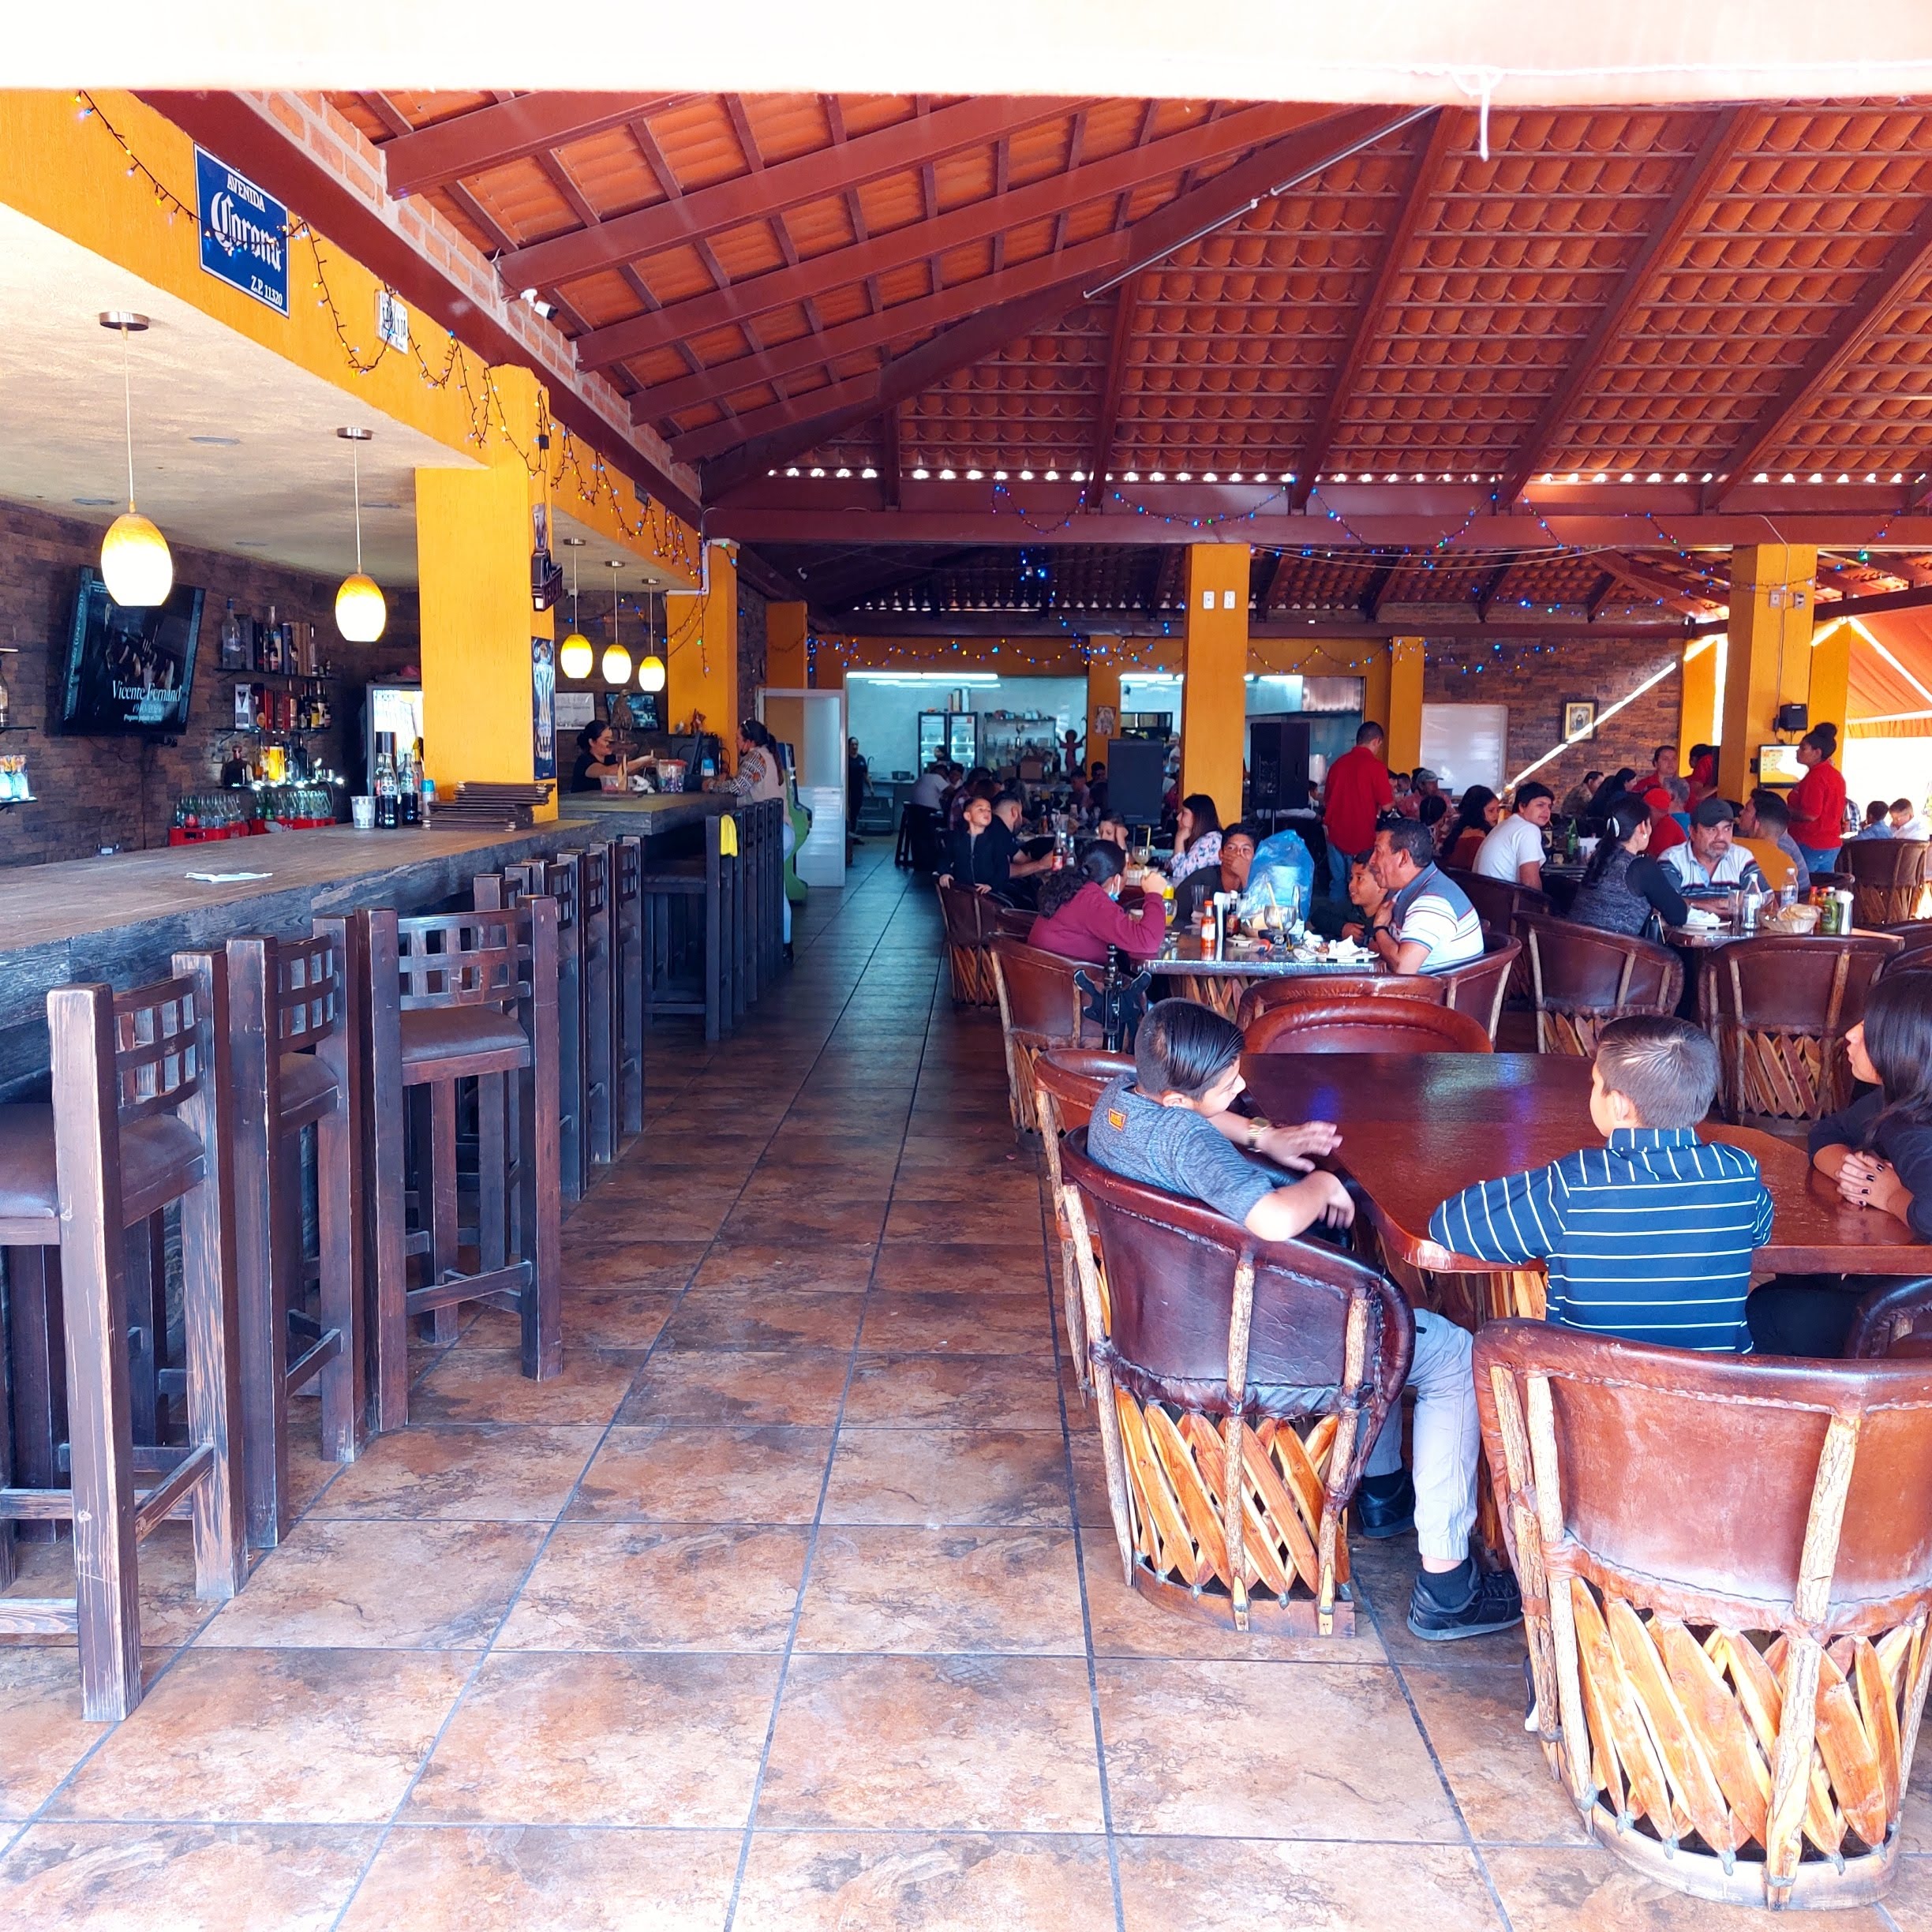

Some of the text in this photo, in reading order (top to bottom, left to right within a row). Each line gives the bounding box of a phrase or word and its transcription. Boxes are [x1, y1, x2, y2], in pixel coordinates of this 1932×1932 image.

[227, 173, 266, 212] AVENIDA
[211, 191, 282, 273] Corona
[250, 275, 283, 307] Z.P. 11320
[112, 680, 146, 701] Vicente
